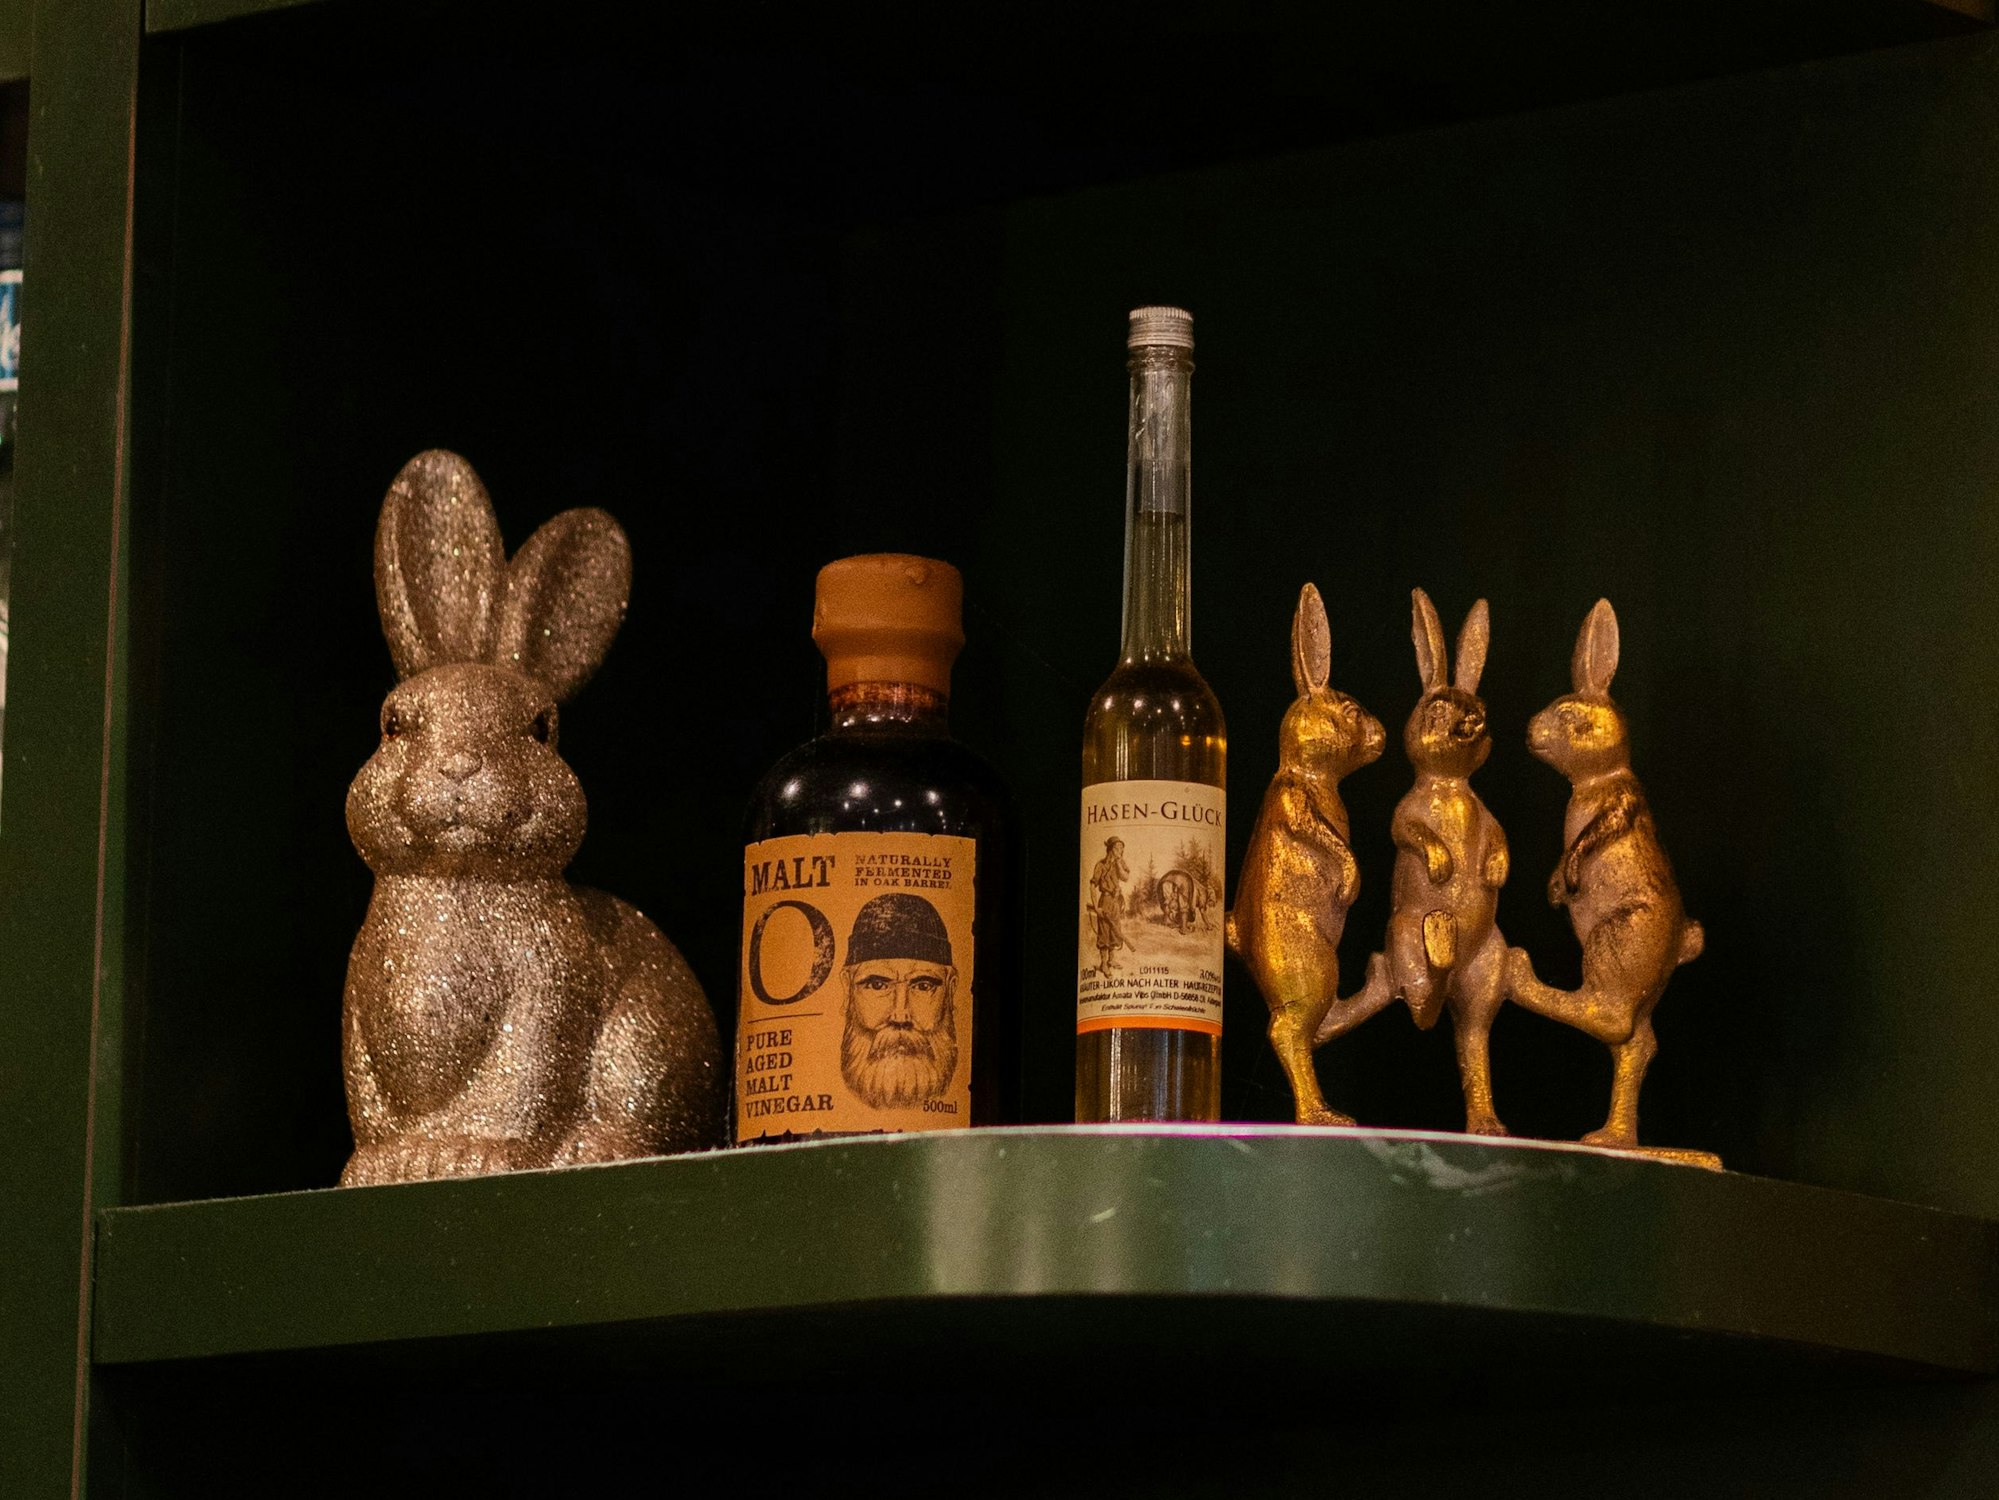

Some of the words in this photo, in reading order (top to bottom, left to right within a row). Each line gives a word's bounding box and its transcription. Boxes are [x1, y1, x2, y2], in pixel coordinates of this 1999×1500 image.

[1087, 801, 1222, 827] HASEN-GLÜCK
[855, 855, 952, 868] NATURALLY
[751, 855, 835, 895] MALT
[855, 867, 952, 880] FERMENTED
[855, 878, 868, 886] IN
[874, 878, 900, 886] OAK
[904, 879, 952, 889] BARREL
[1127, 979, 1151, 988] NACH
[1153, 979, 1179, 989] ALTER
[746, 1029, 792, 1051] PURE
[746, 1052, 793, 1074] AGED
[746, 1074, 793, 1096] MALT
[746, 1094, 834, 1118] VINEGAR
[923, 1100, 958, 1114] 500ml
